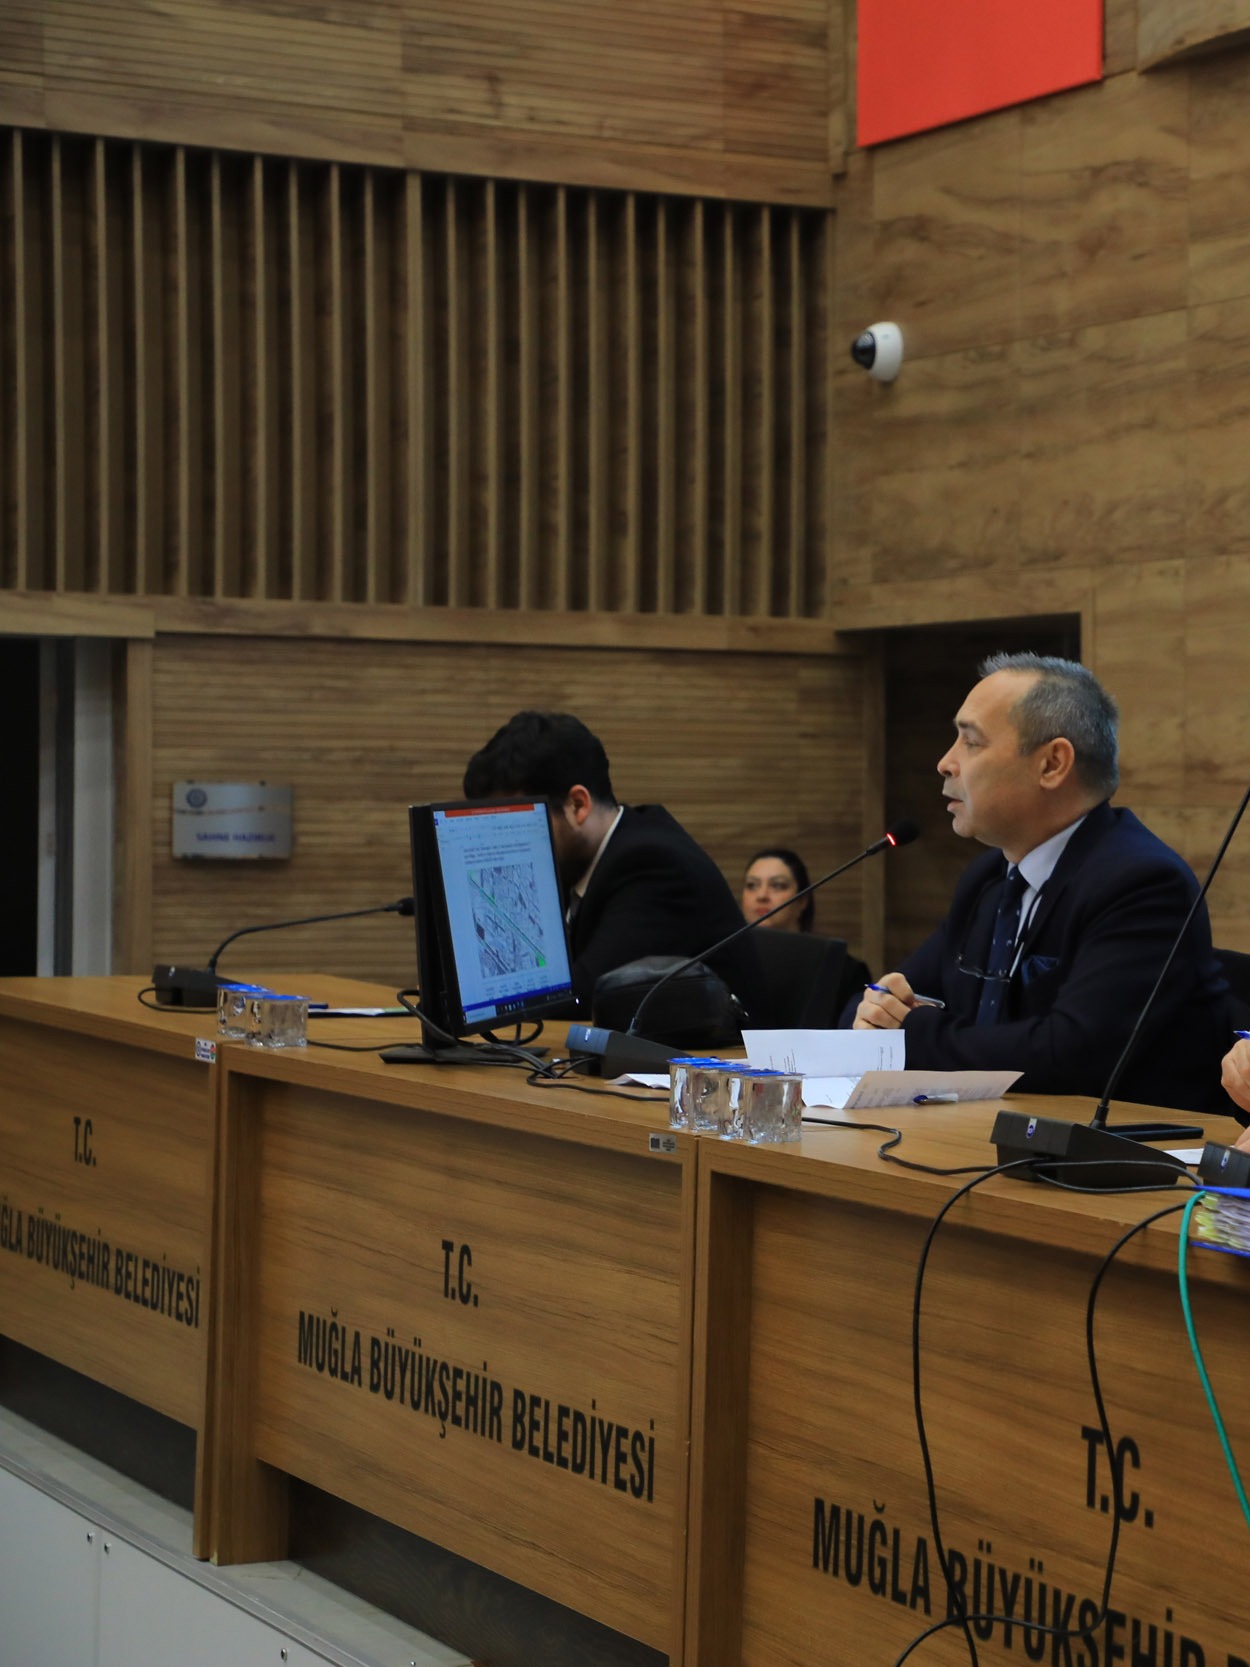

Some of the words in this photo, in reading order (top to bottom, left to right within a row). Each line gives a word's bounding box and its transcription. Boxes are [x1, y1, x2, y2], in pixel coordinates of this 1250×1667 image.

[73, 1116, 97, 1167] T.C.
[27, 1206, 110, 1291] BÜYÜKŞEHİR
[114, 1247, 201, 1329] BELEDİYESİ
[441, 1239, 480, 1308] T.C.
[298, 1306, 363, 1388] MUĞLA
[369, 1327, 504, 1444] BÜYÜKŞEHİR
[511, 1387, 656, 1503] BELEDİYESİ
[1081, 1425, 1154, 1529] T.C.
[812, 1496, 933, 1617] MUĞLA
